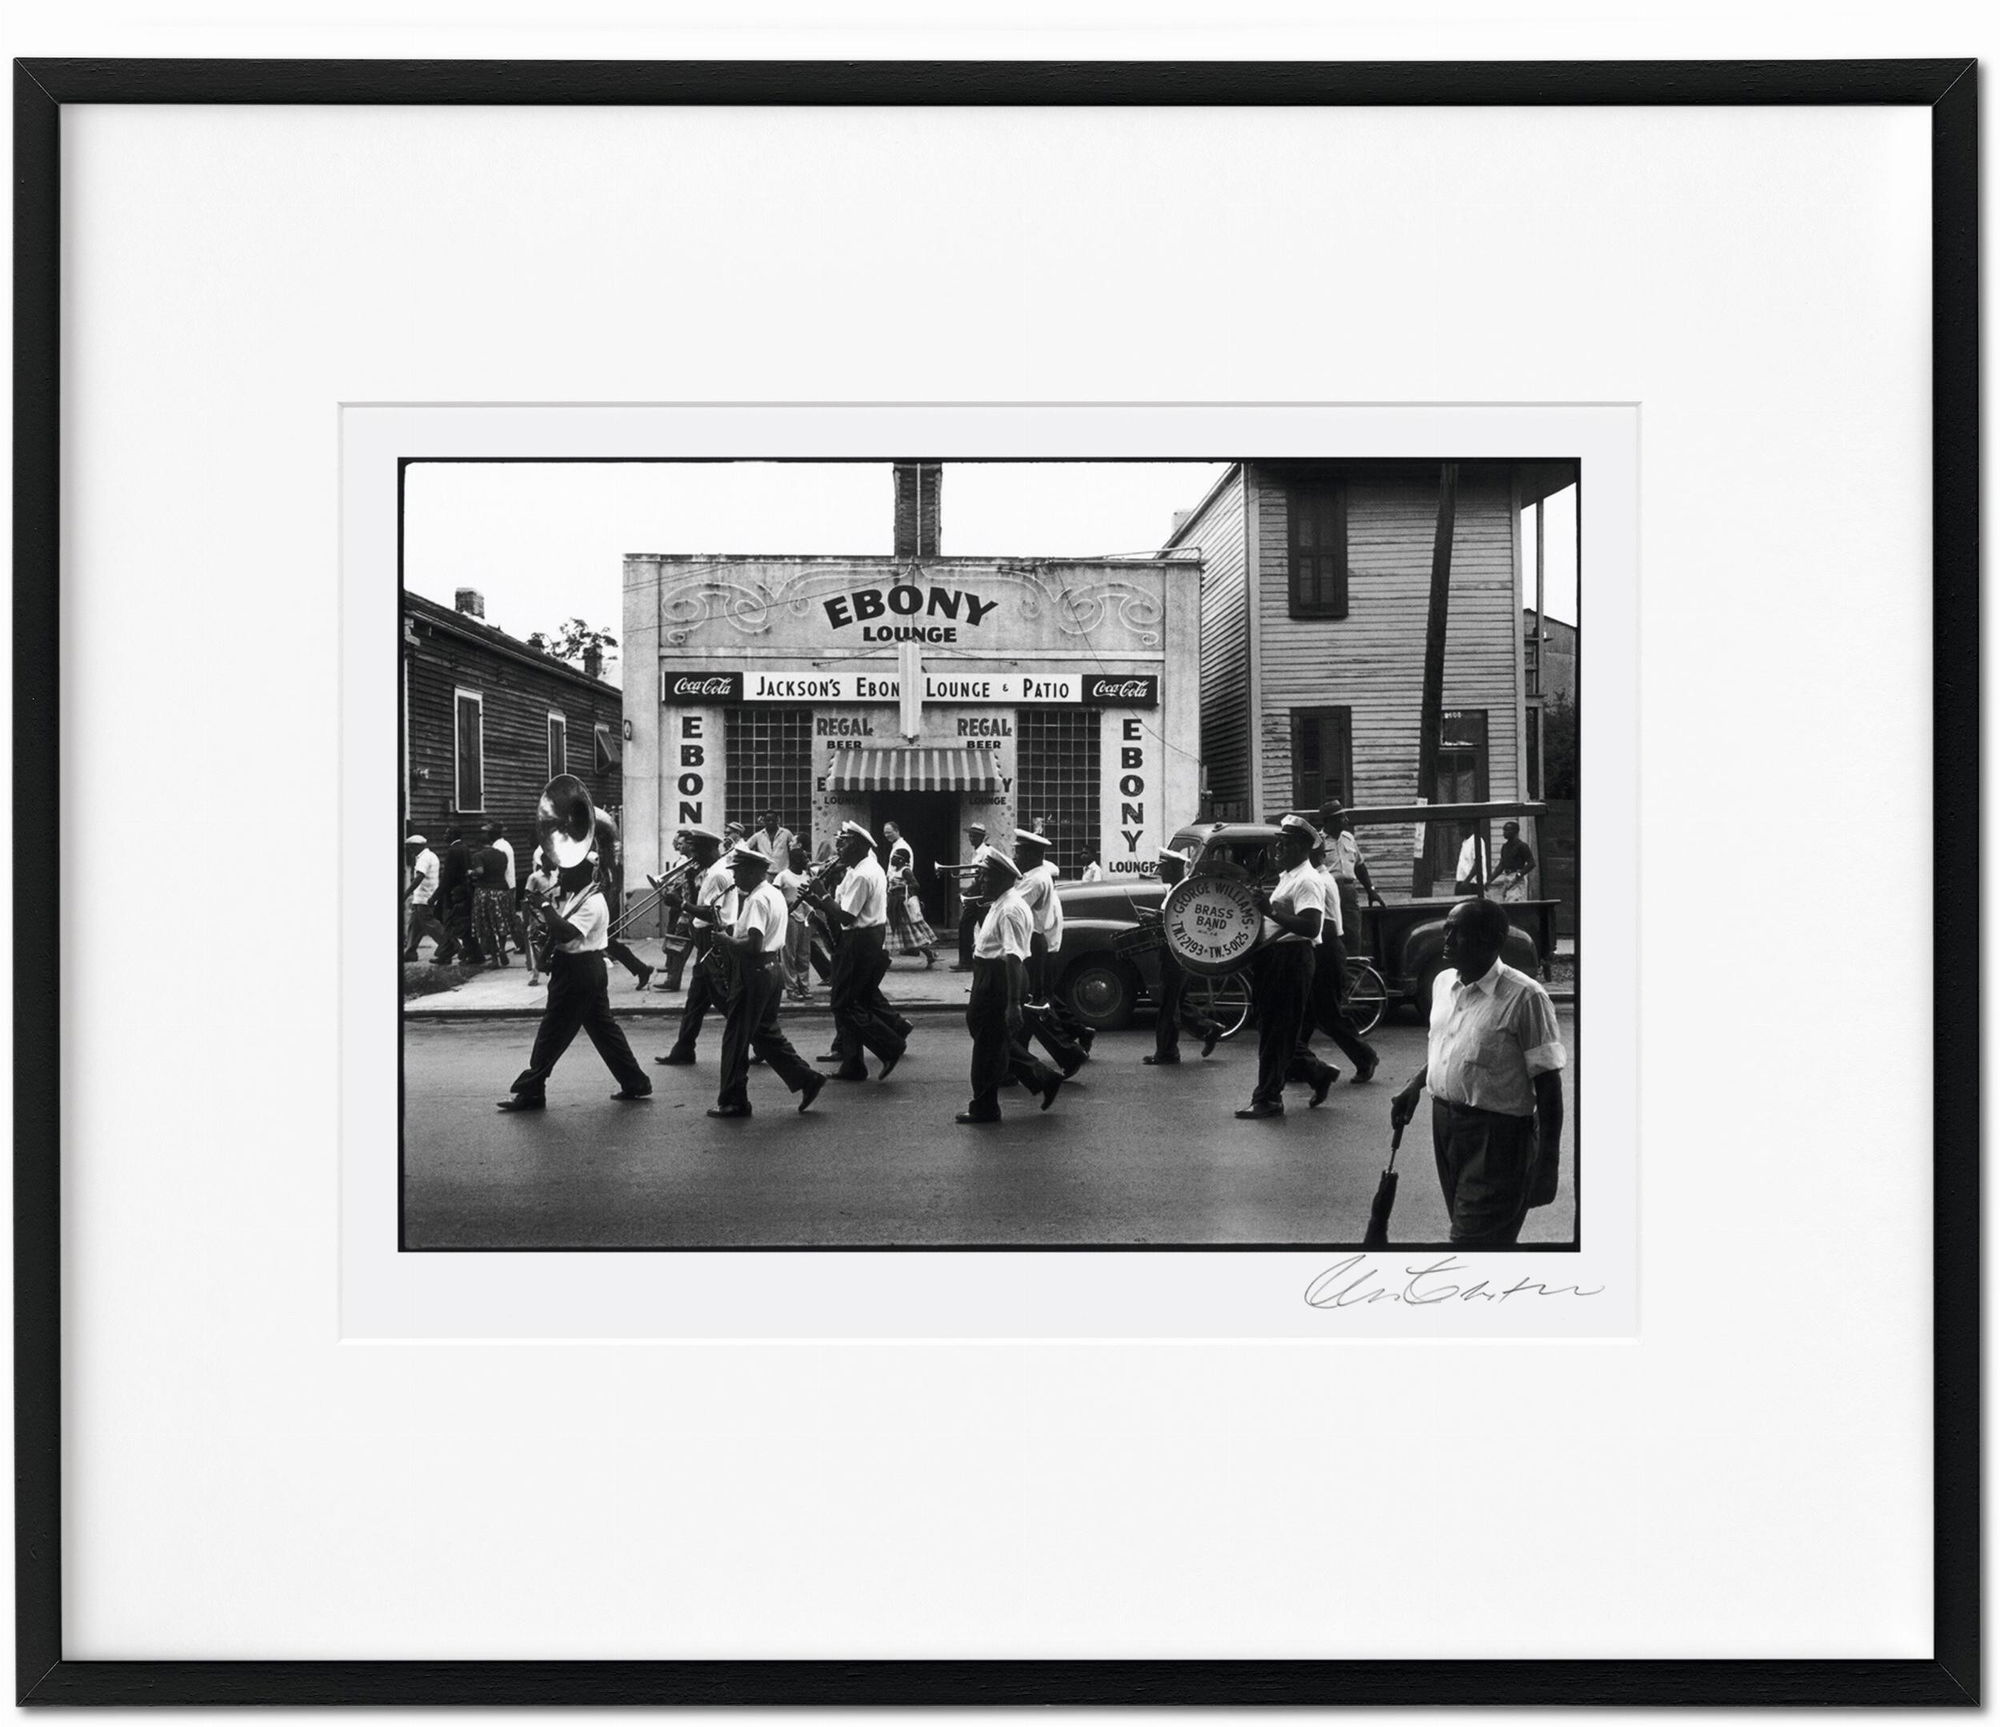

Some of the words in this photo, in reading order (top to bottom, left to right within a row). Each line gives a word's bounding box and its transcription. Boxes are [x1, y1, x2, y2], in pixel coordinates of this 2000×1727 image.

[823, 584, 999, 630] EBONY
[863, 626, 957, 642] LOUNGE
[673, 677, 734, 695] Coca-Cola
[756, 676, 841, 697] JACKSON'S
[856, 677, 900, 697] EBON
[926, 678, 990, 698] LOUNGE
[1002, 684, 1009, 692] &
[1023, 678, 1069, 698] PATIO
[1092, 680, 1150, 698] Coca-Cola
[816, 718, 874, 737] REGAL
[957, 718, 1012, 737] REGAL
[827, 740, 862, 750] BEER
[967, 740, 1001, 749] BEER
[1119, 719, 1144, 853] EBONY
[1173, 882, 1210, 913] GEORGE
[1215, 882, 1254, 925] WILLIAMS
[1195, 904, 1234, 919] BRASS
[1196, 916, 1227, 930] BAND
